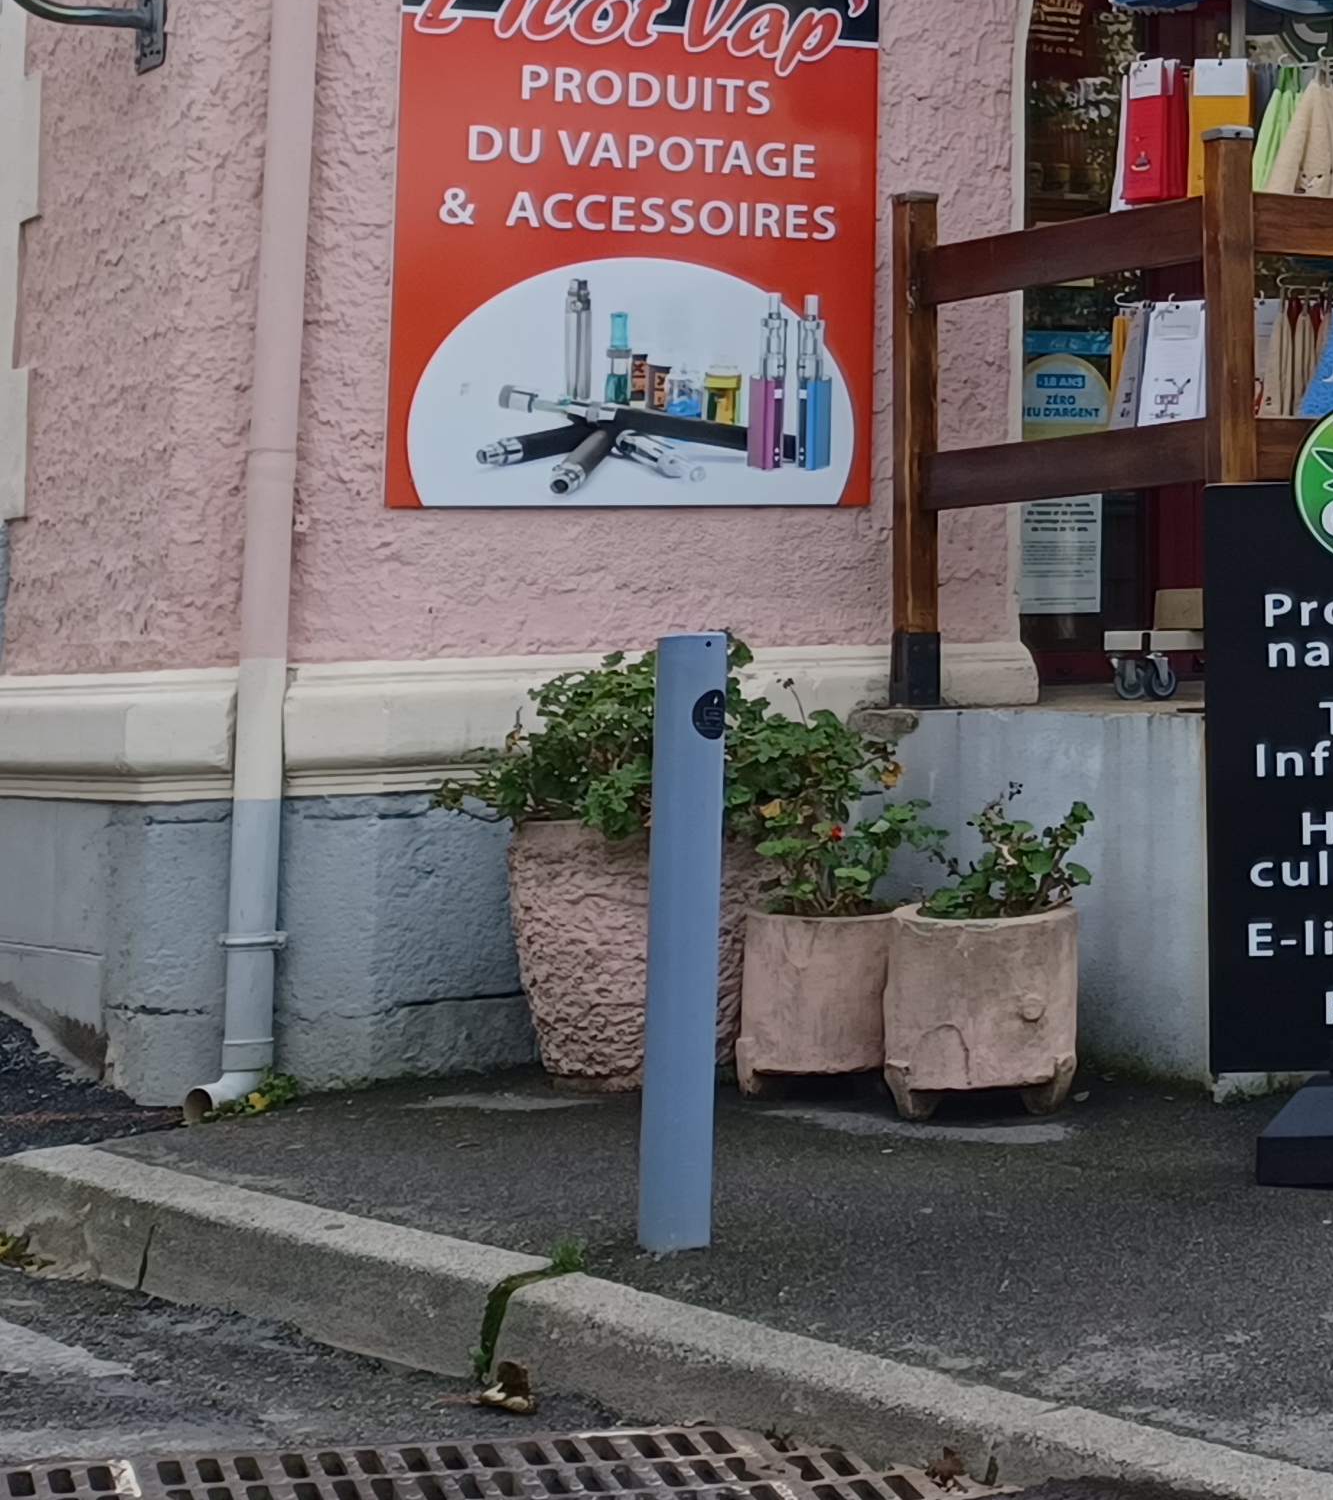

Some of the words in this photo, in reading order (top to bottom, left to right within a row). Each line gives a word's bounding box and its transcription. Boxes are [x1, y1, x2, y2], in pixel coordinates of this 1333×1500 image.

[520, 64, 772, 116] PRODUITS
[467, 123, 542, 164] DU
[557, 129, 816, 180] VAPOTAGE
[438, 187, 476, 226] &
[505, 191, 838, 241] ACCESSOIRES
[1058, 376, 1084, 388] ANS
[1043, 407, 1100, 418] D'ARGENT
[1045, 392, 1077, 406] ZÉRO
